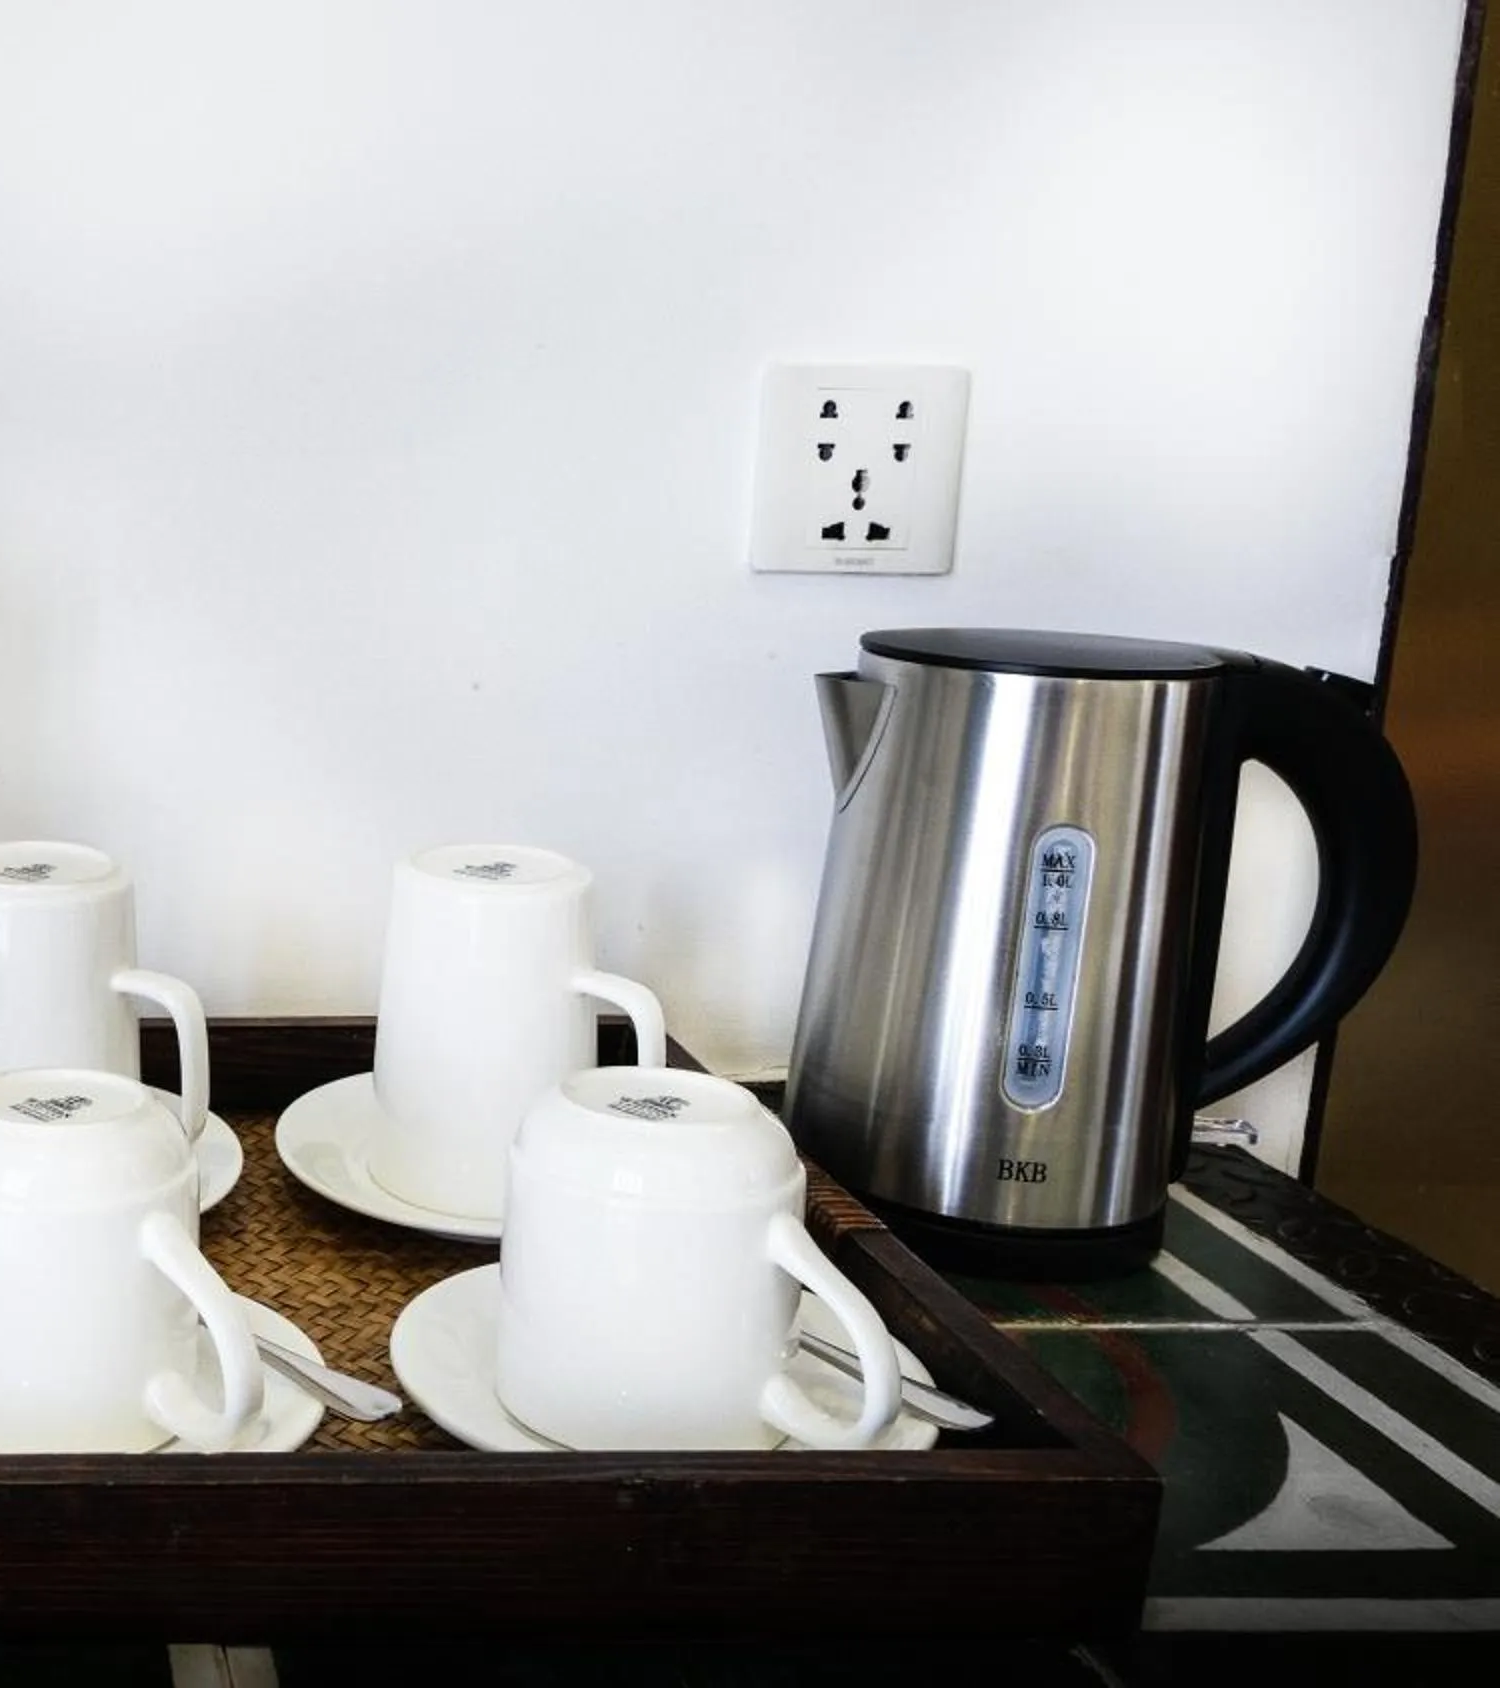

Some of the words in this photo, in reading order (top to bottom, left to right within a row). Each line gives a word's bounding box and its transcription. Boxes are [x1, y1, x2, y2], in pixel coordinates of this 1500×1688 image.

[1041, 852, 1076, 869] MAX
[1025, 991, 1057, 1006] 0.5L
[1016, 1061, 1051, 1077] MIN
[997, 1159, 1047, 1183] BKB
